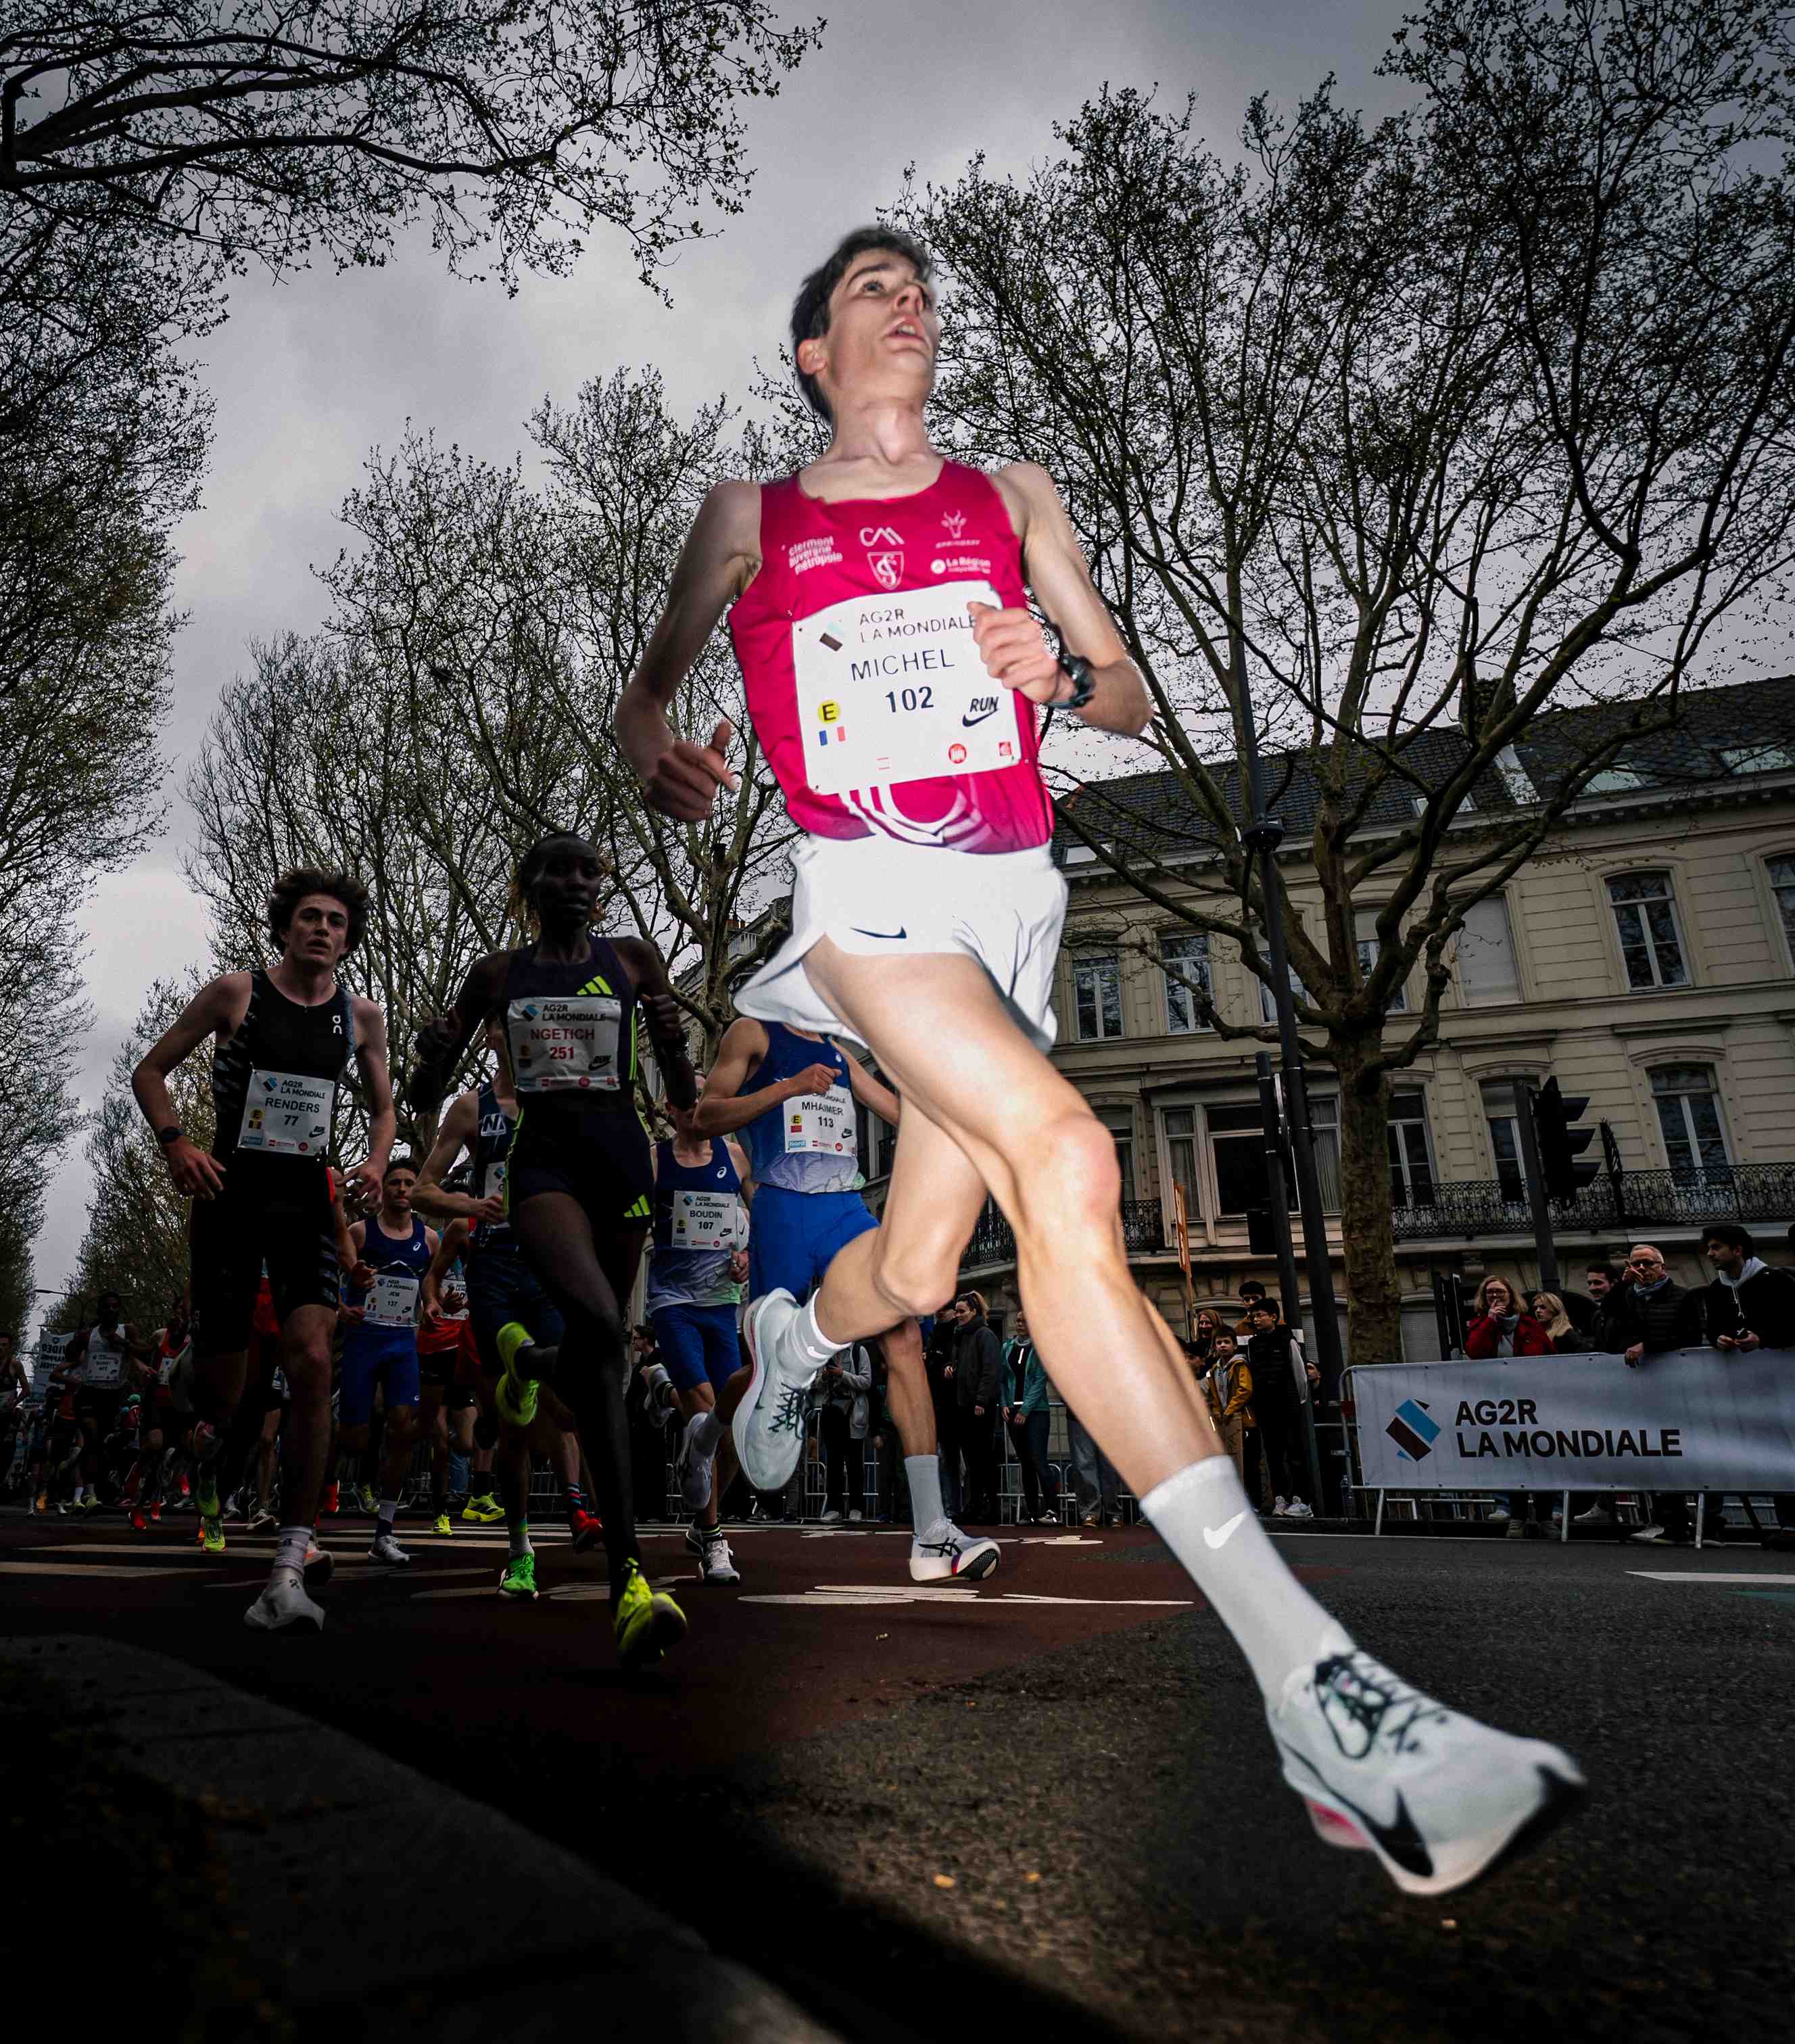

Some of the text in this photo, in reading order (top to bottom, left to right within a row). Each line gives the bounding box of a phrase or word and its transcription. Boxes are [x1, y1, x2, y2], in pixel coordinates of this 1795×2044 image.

[789, 536, 834, 556] clermont
[860, 609, 905, 625] AG2R
[861, 629, 882, 642] LA
[851, 649, 955, 681] MICHEL
[886, 686, 934, 713] 102
[970, 696, 999, 713] RUN
[822, 703, 837, 721] E
[543, 1004, 568, 1012] AG2R
[557, 1013, 606, 1021] MONDIALE
[531, 1028, 595, 1040] NGETICH
[550, 1047, 574, 1060] 251
[282, 1080, 303, 1089] AG2R
[292, 1089, 325, 1099] MONDIALE
[265, 1097, 320, 1113] RENDERS
[802, 1102, 844, 1116] MHAIMER
[284, 1115, 299, 1126] 77
[793, 1115, 800, 1124] E
[818, 1116, 834, 1128] 113
[690, 1210, 723, 1218] BOUDIN
[698, 1221, 714, 1230] 107
[1455, 1399, 1539, 1426] AG2R
[1456, 1429, 1682, 1458] LA MONDIALE
